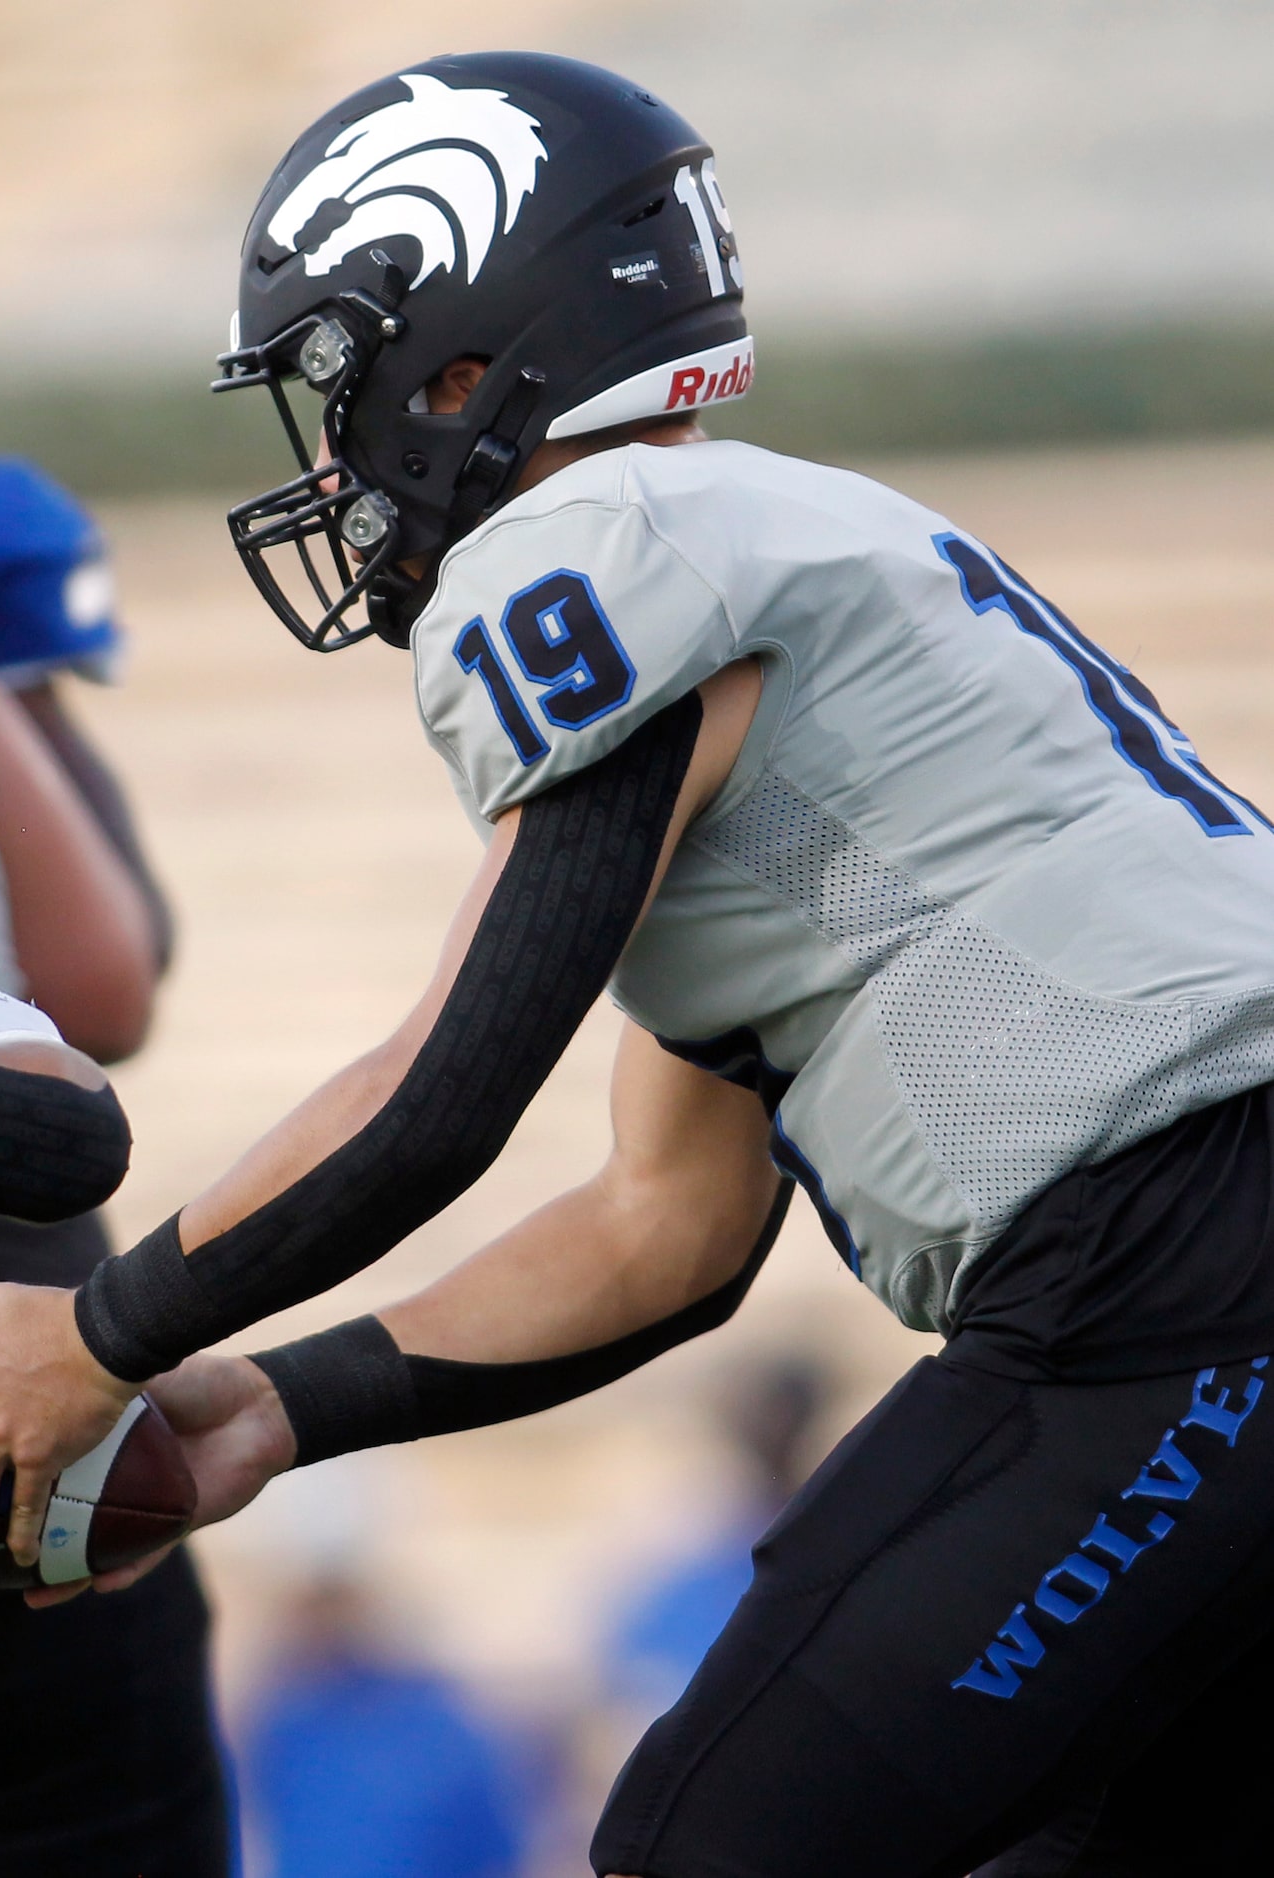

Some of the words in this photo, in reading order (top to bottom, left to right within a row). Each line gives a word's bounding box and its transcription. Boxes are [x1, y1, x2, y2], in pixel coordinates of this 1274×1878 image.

[611, 260, 654, 279] Riddell
[664, 351, 753, 411] Ridd
[453, 567, 638, 766] 19
[950, 1355, 1270, 1699] WOLVE
